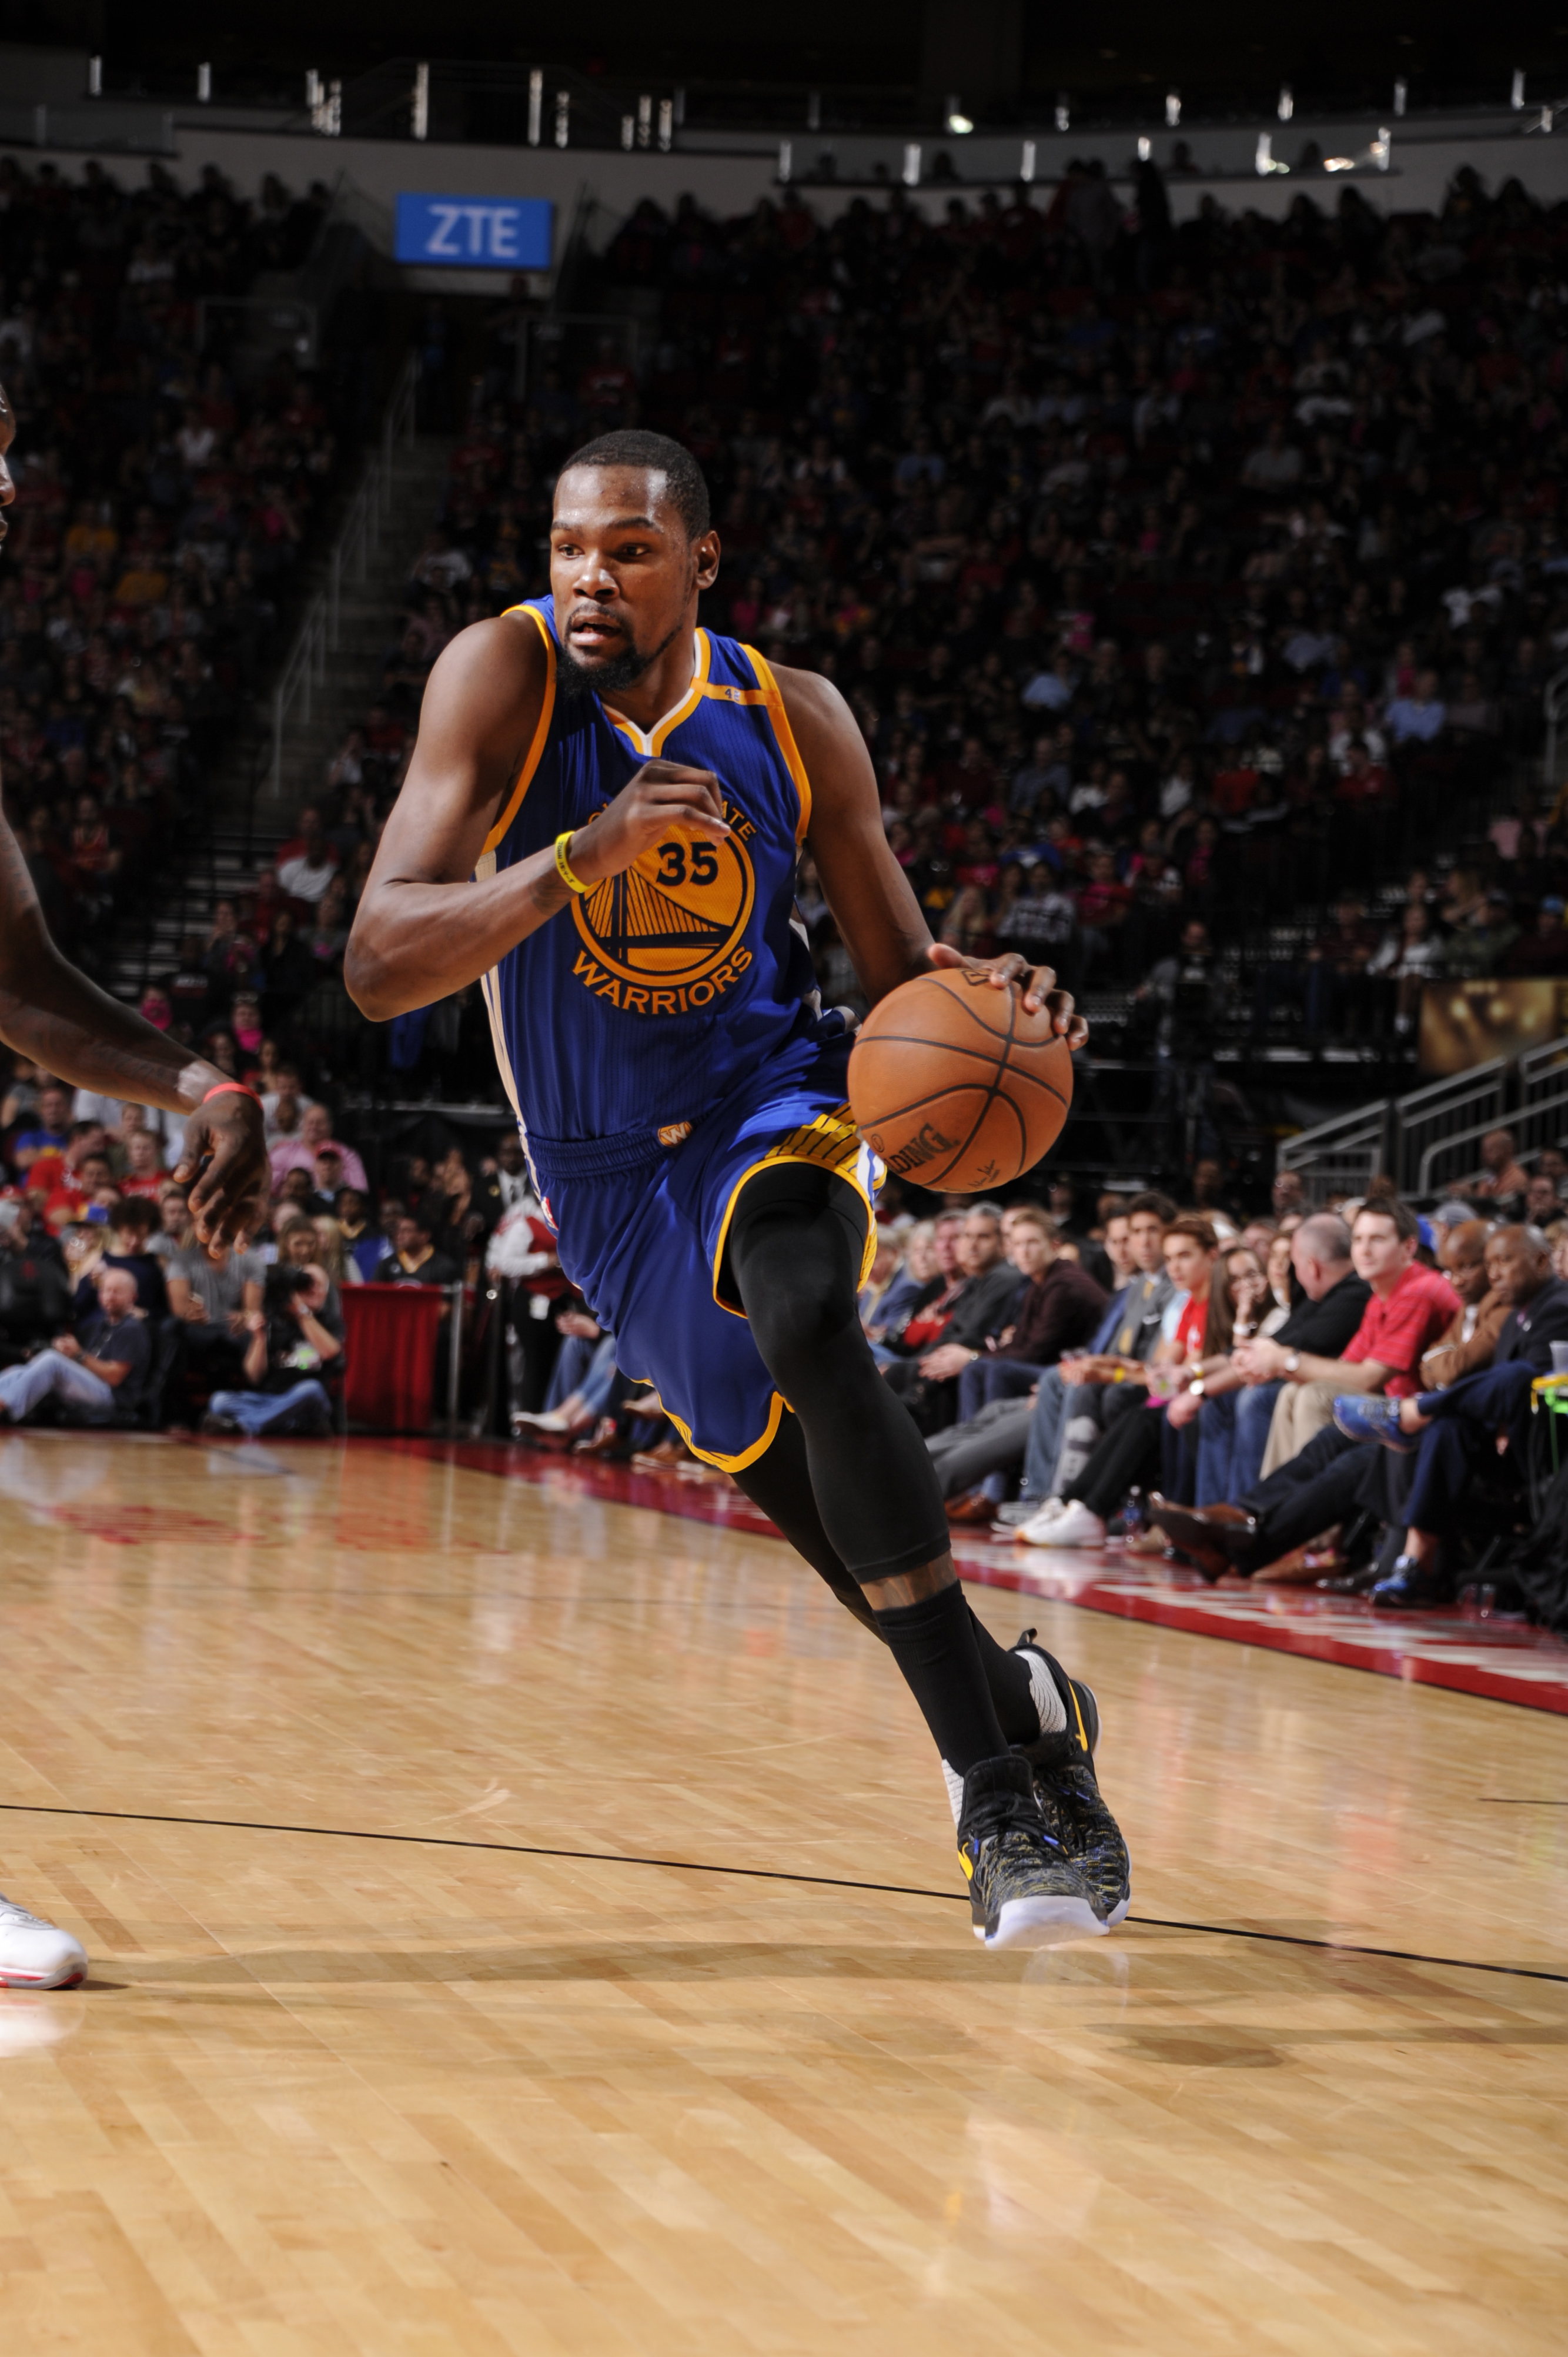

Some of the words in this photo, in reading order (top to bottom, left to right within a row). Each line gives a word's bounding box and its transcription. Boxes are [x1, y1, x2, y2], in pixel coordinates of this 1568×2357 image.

[426, 203, 520, 258] ZTE
[656, 842, 718, 886] 35
[573, 946, 753, 1014] WARRIORS
[884, 1123, 954, 1174] LDING
